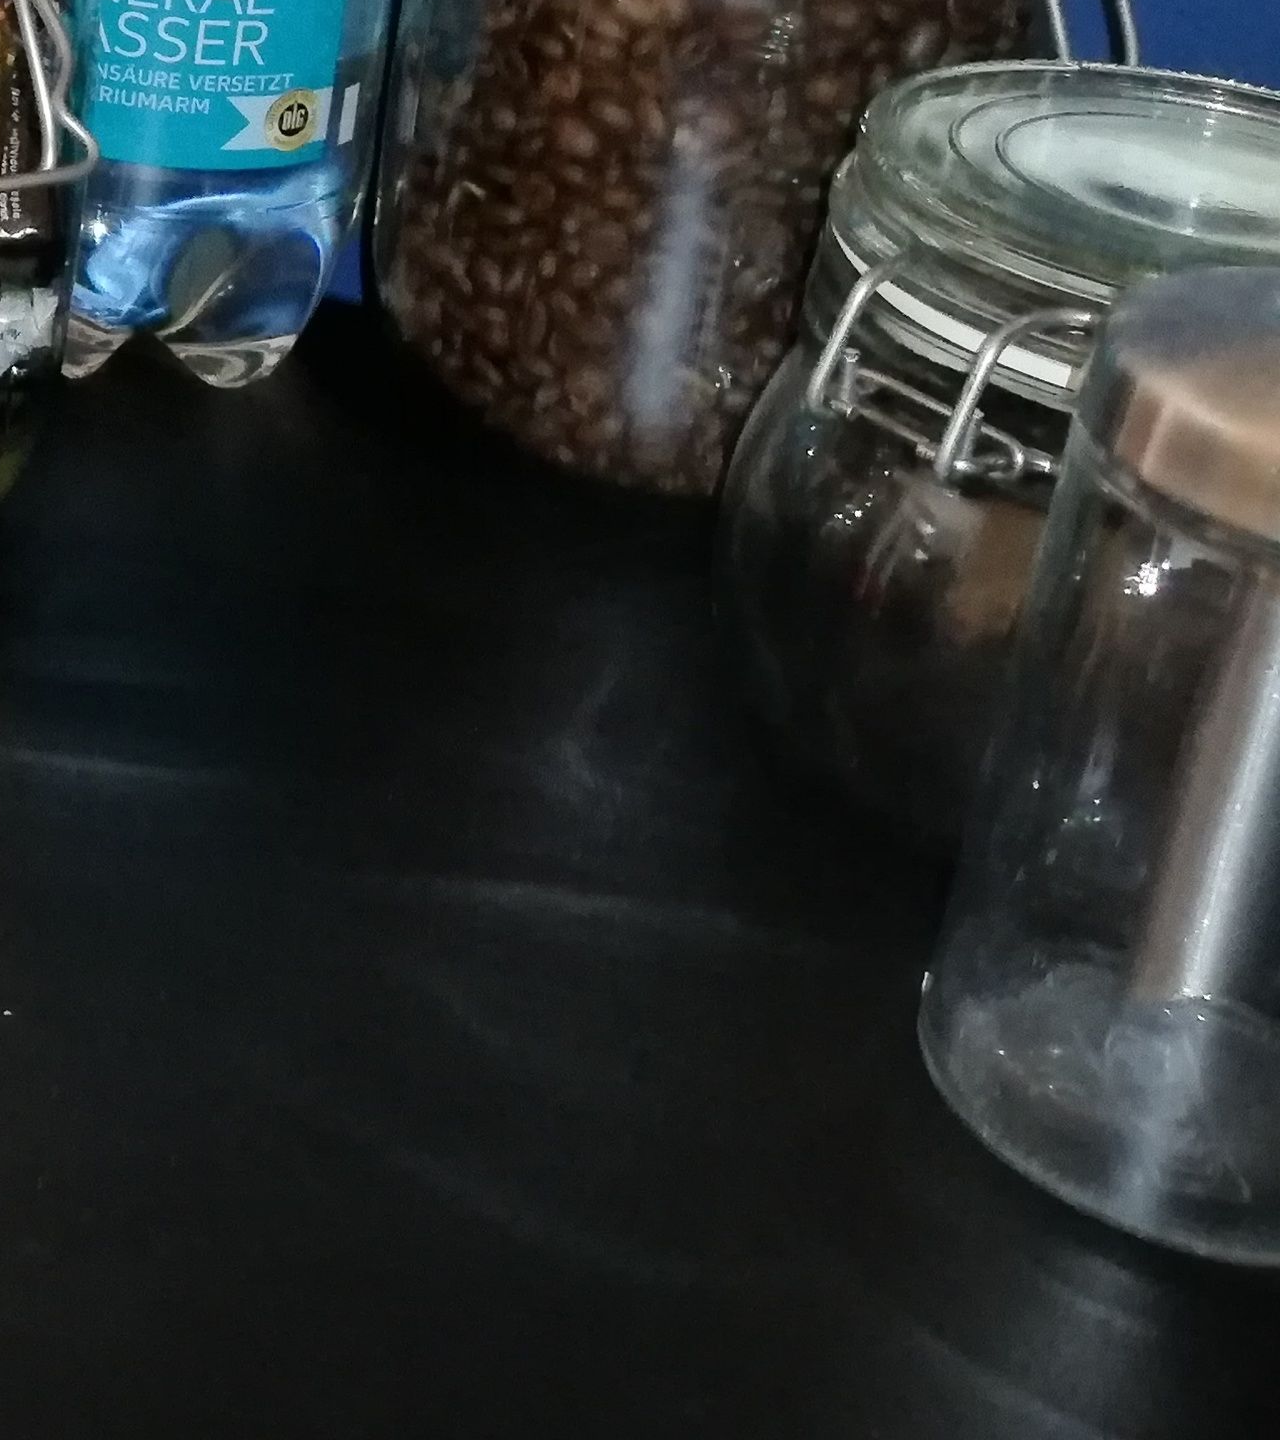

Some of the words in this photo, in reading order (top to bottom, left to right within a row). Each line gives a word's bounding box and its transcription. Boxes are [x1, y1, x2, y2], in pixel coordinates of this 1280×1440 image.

[97, 10, 269, 66] SSER
[189, 72, 295, 94] VERSETZT
[97, 86, 210, 115] RIUMARM
